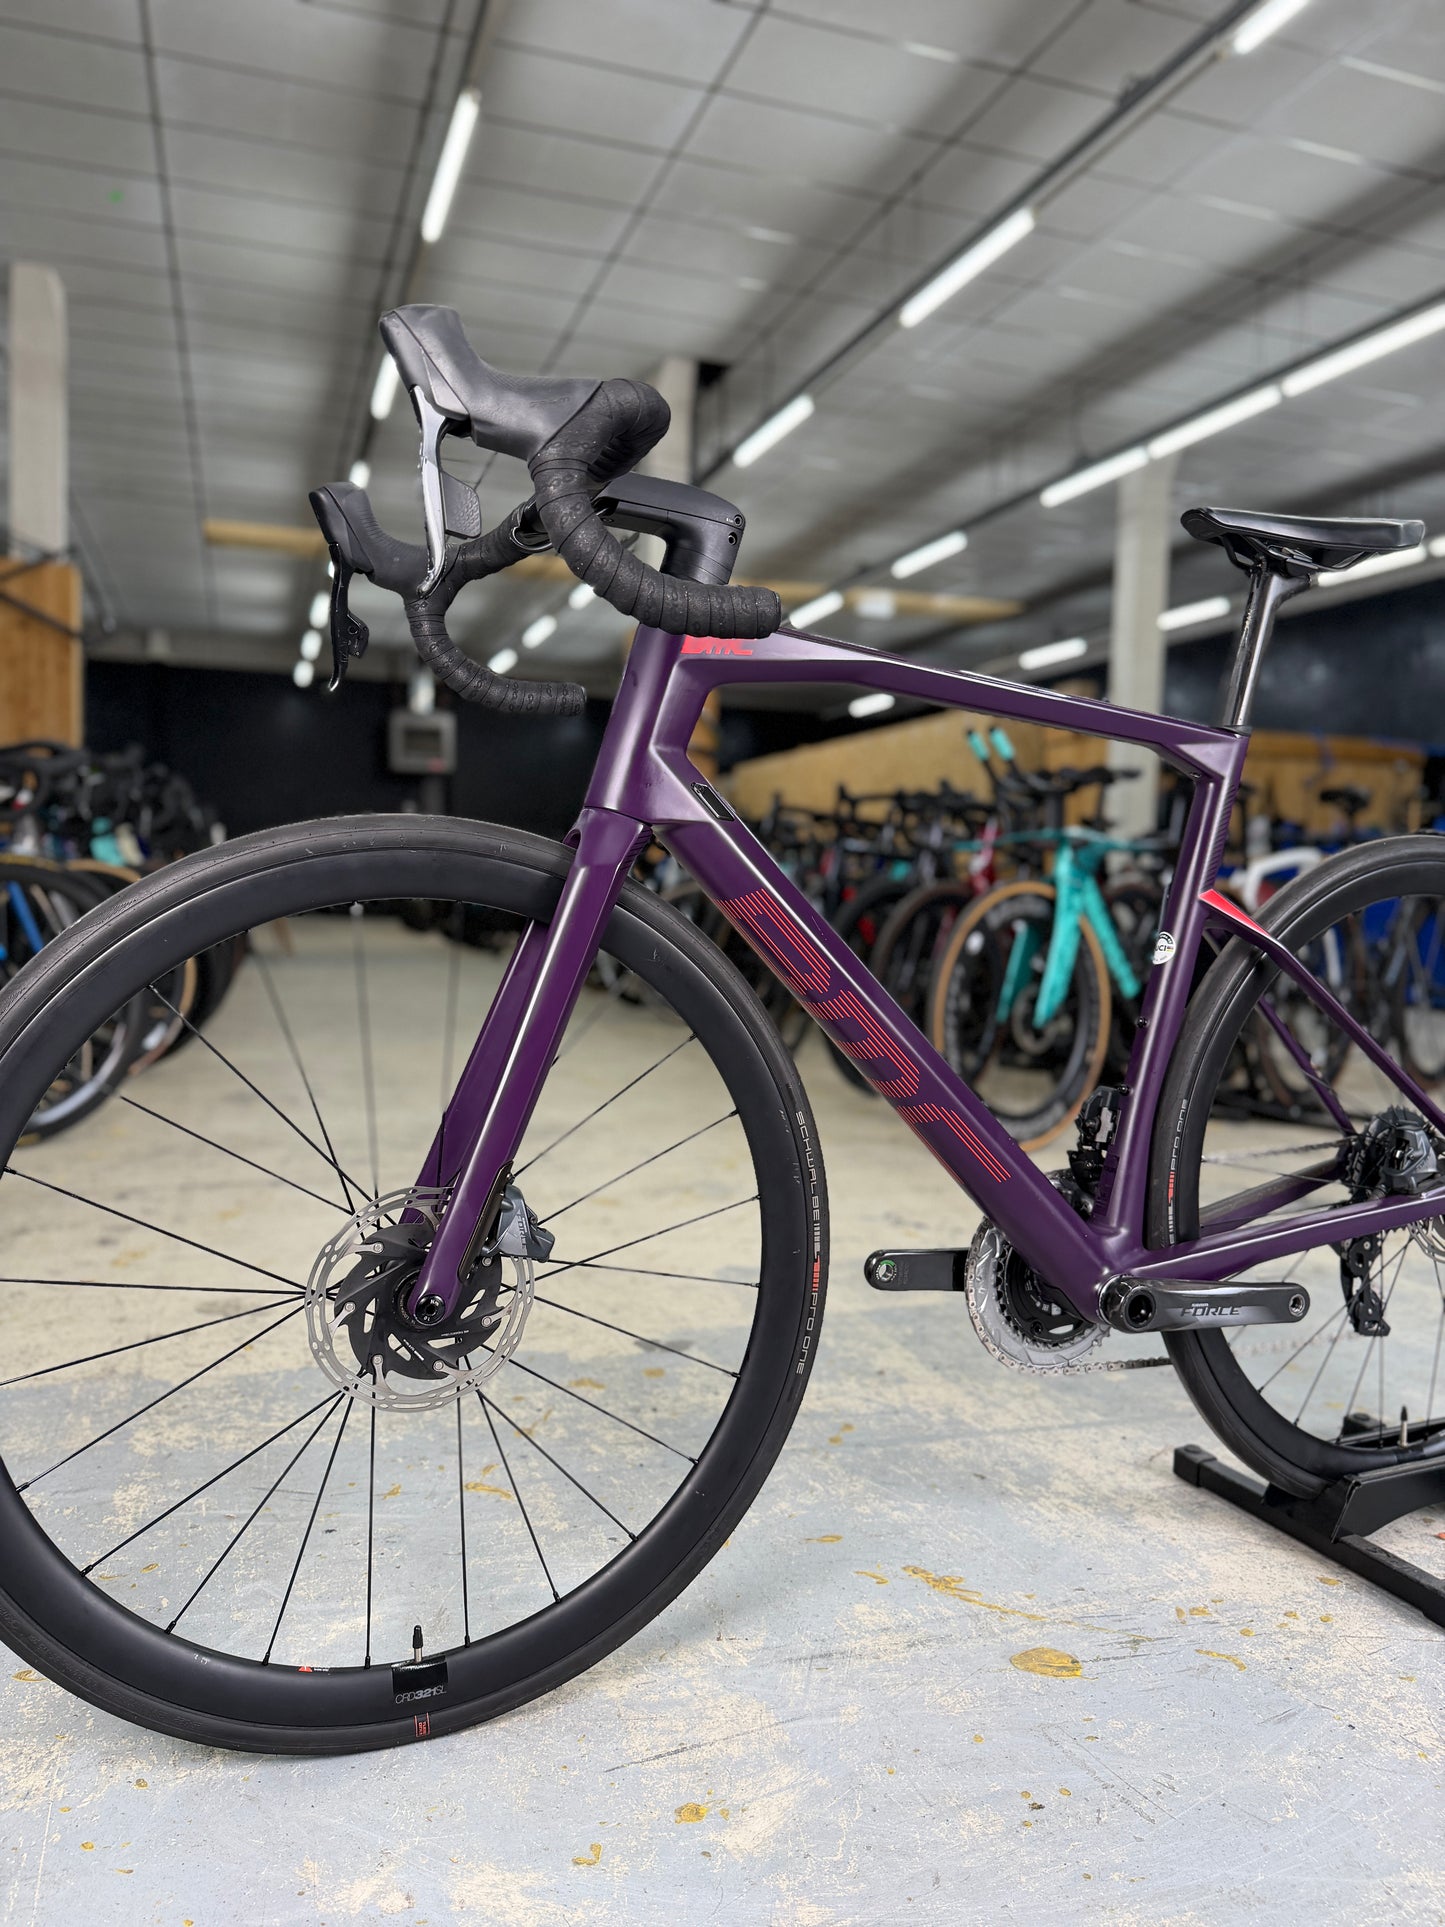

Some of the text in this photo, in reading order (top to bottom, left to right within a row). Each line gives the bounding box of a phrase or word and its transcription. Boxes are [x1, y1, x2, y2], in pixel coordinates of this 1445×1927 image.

[796, 1110, 820, 1221] SCHWALBE
[1180, 1306, 1240, 1317] FORCE
[796, 1335, 813, 1374] ONE
